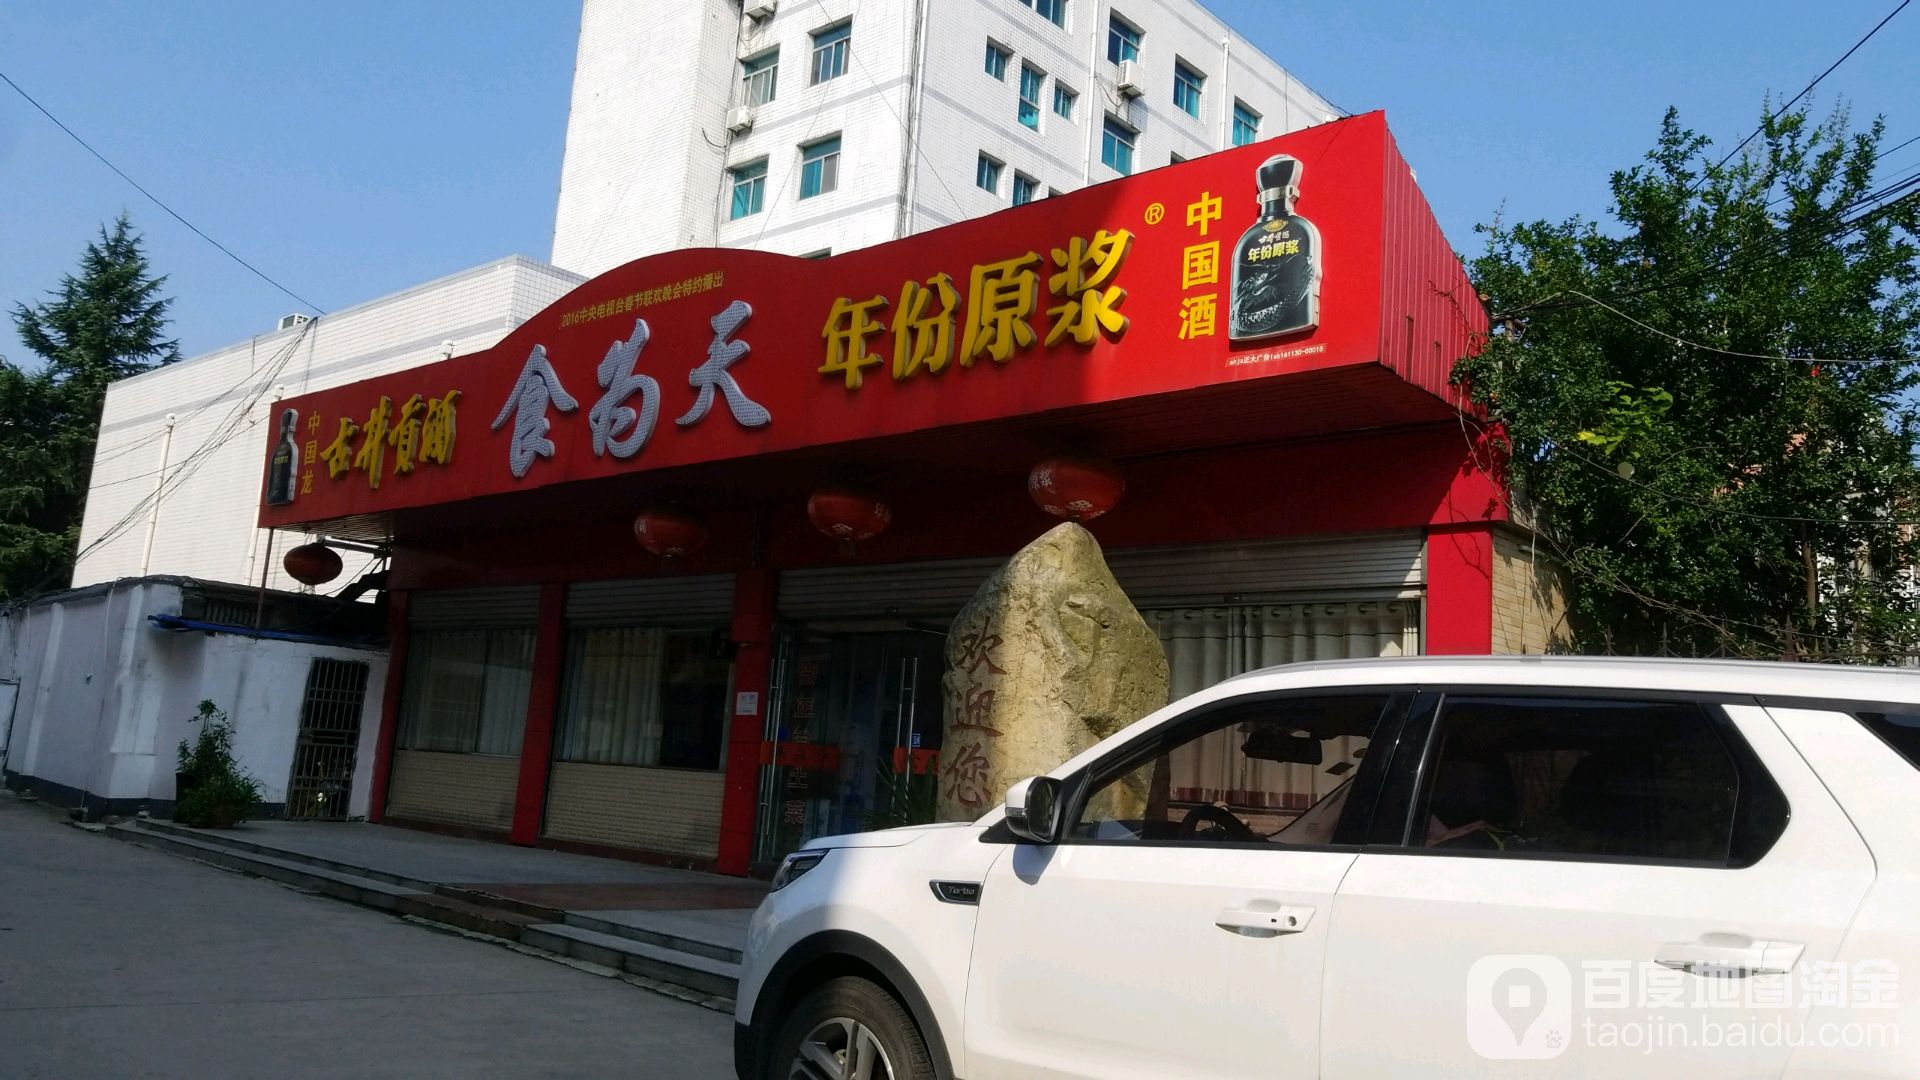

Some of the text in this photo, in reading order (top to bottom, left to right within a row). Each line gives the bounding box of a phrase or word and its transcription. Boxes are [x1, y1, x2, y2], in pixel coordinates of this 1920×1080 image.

[561, 270, 724, 327] 2016中央电视台春节联欢晚会特约播出
[818, 227, 1136, 390] 年份原浆
[1177, 191, 1223, 341] 中国酒
[1248, 240, 1299, 262] 年份原浆
[321, 389, 464, 489] 古井贡酒
[491, 299, 772, 478] 食为天
[301, 410, 321, 495] 中国龙
[945, 616, 1007, 809] 欢迎您
